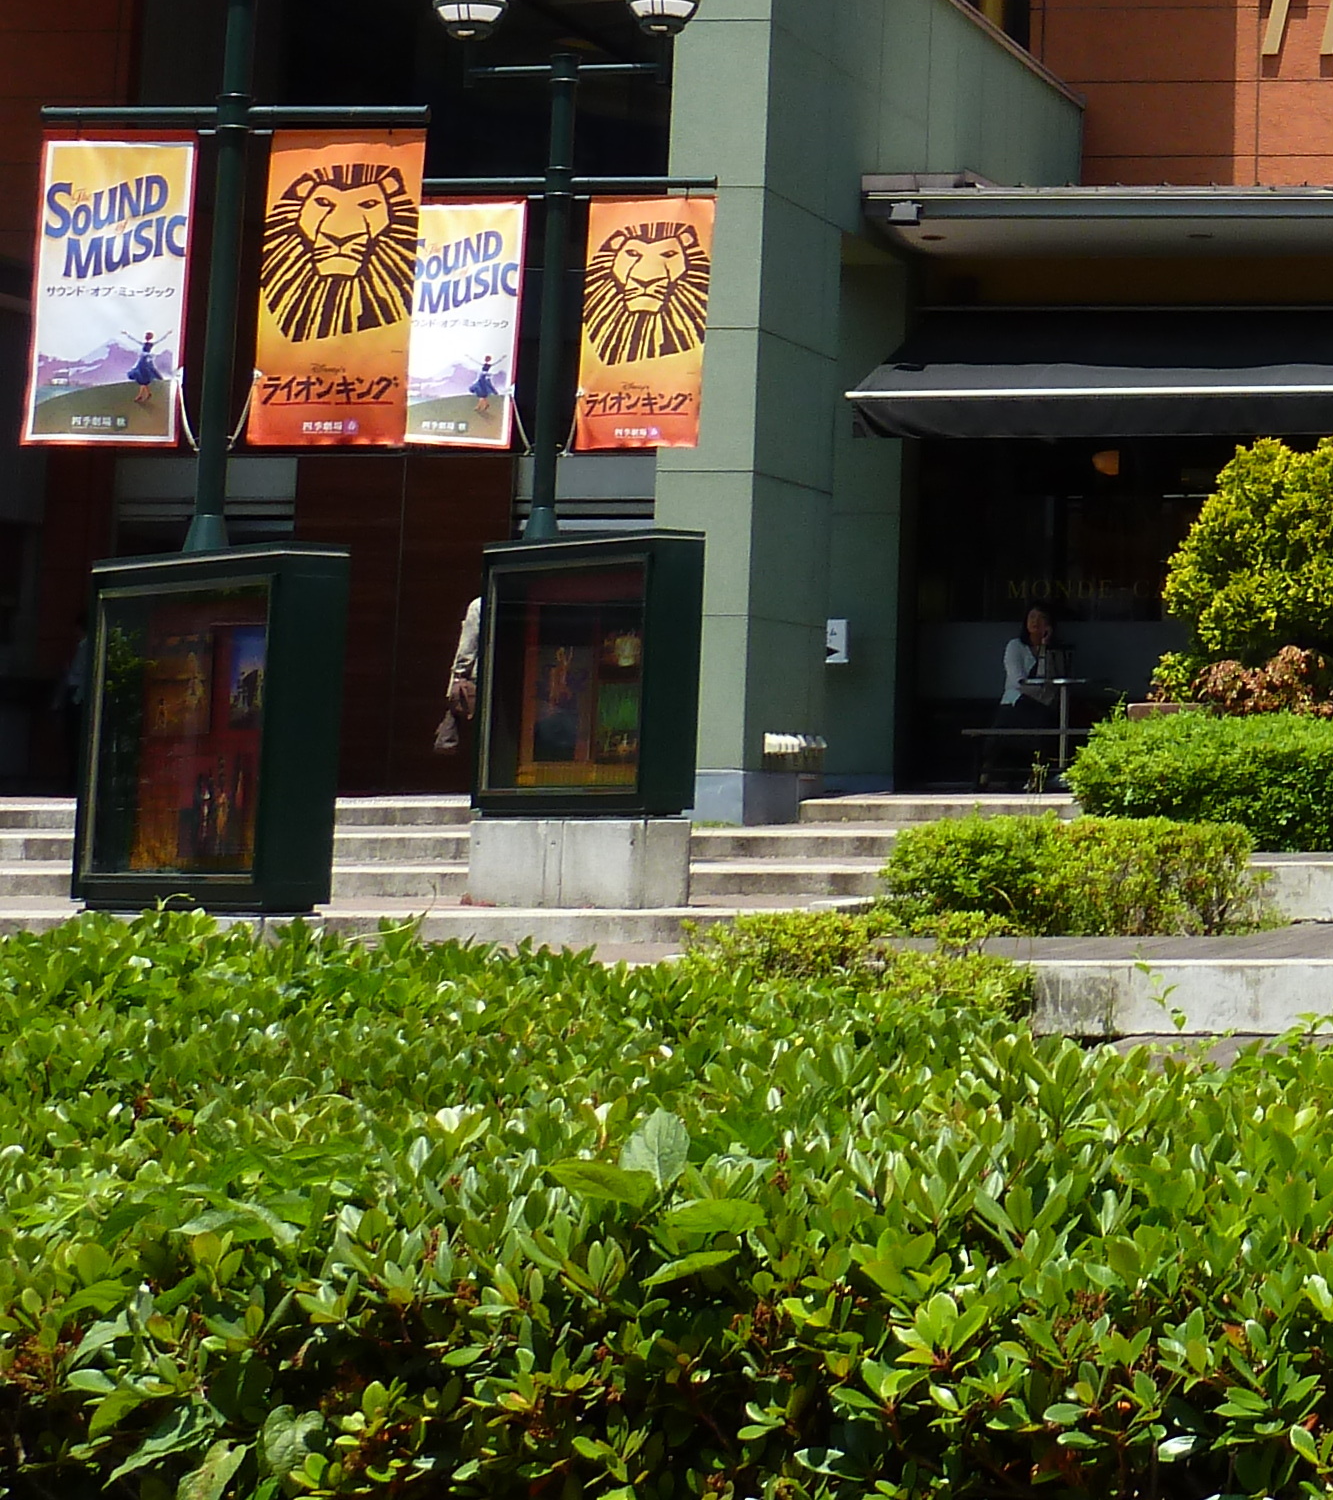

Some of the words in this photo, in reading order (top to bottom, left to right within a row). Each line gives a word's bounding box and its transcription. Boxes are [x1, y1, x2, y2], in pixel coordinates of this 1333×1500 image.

[62, 214, 188, 279] MUSIC
[418, 262, 519, 314] MUSIC
[262, 376, 399, 404] ライオンキング
[585, 392, 693, 417] ライオンキング
